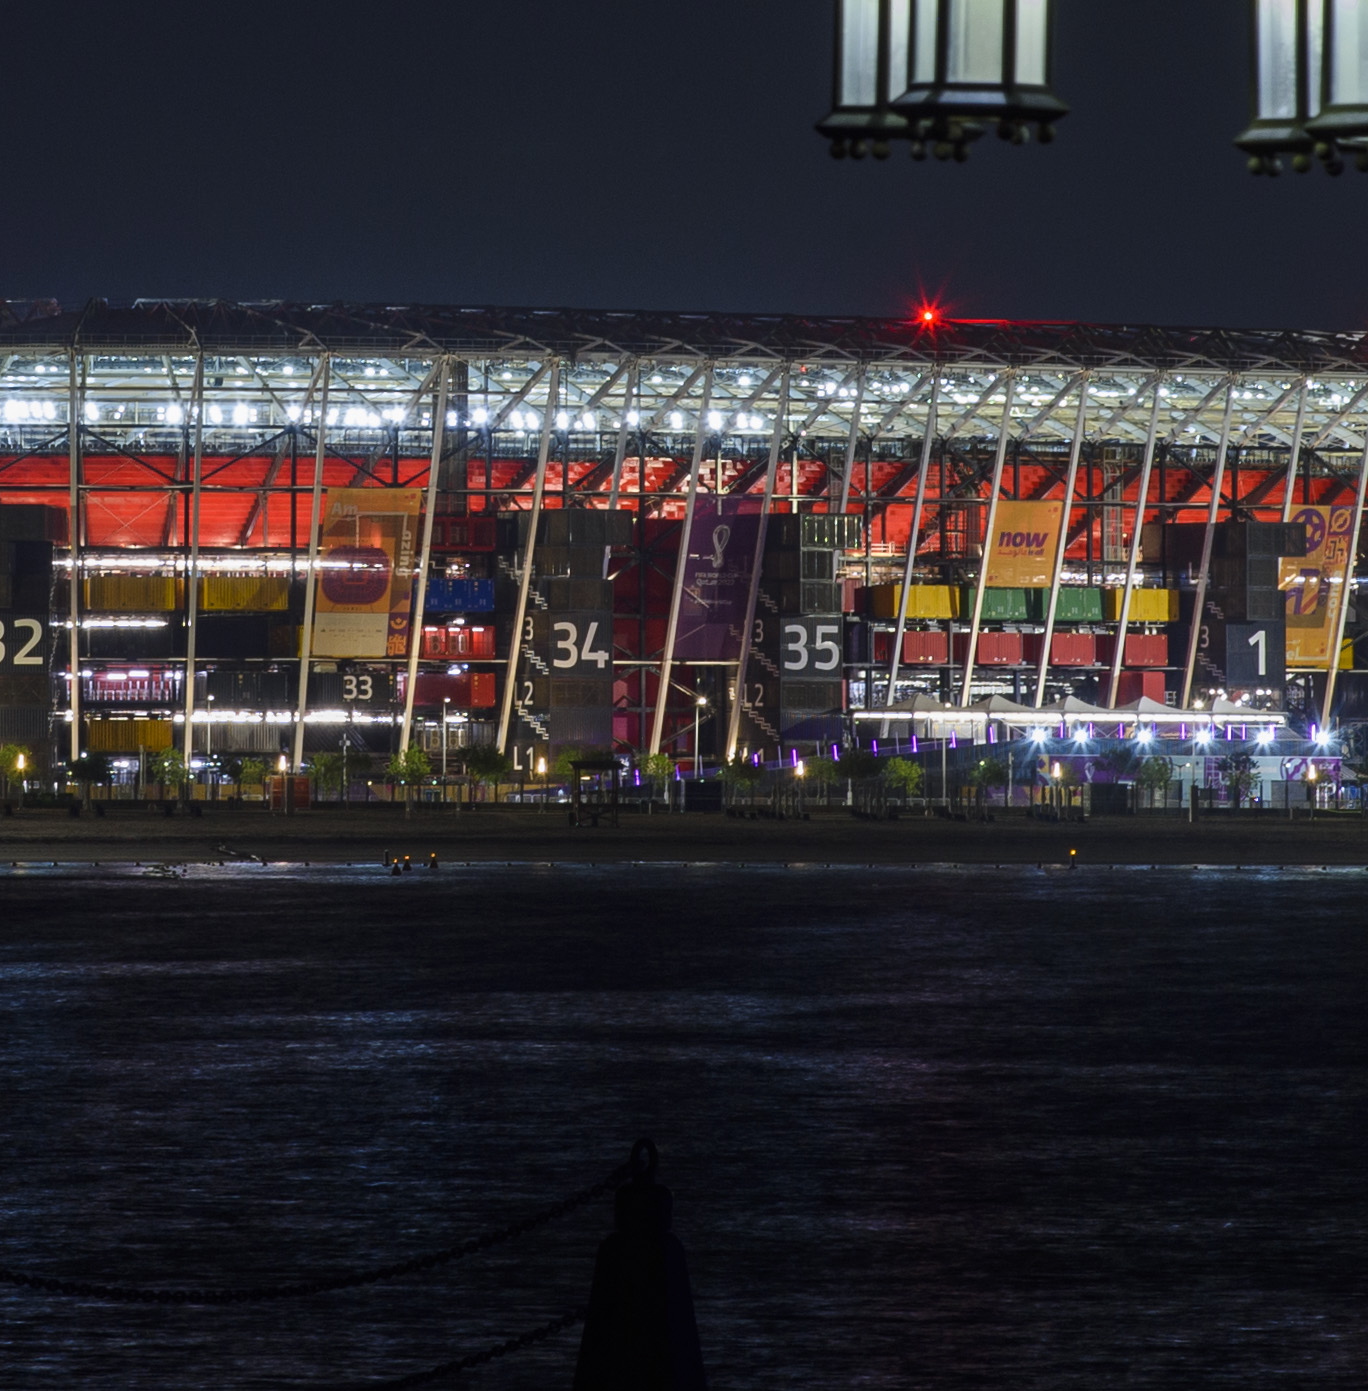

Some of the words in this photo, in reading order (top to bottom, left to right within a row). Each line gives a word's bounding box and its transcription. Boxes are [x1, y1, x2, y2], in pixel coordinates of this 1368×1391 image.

[998, 531, 1049, 548] now
[552, 622, 609, 668] 34
[784, 624, 840, 670] 35
[1248, 630, 1266, 676] 1
[343, 675, 372, 699] 33
